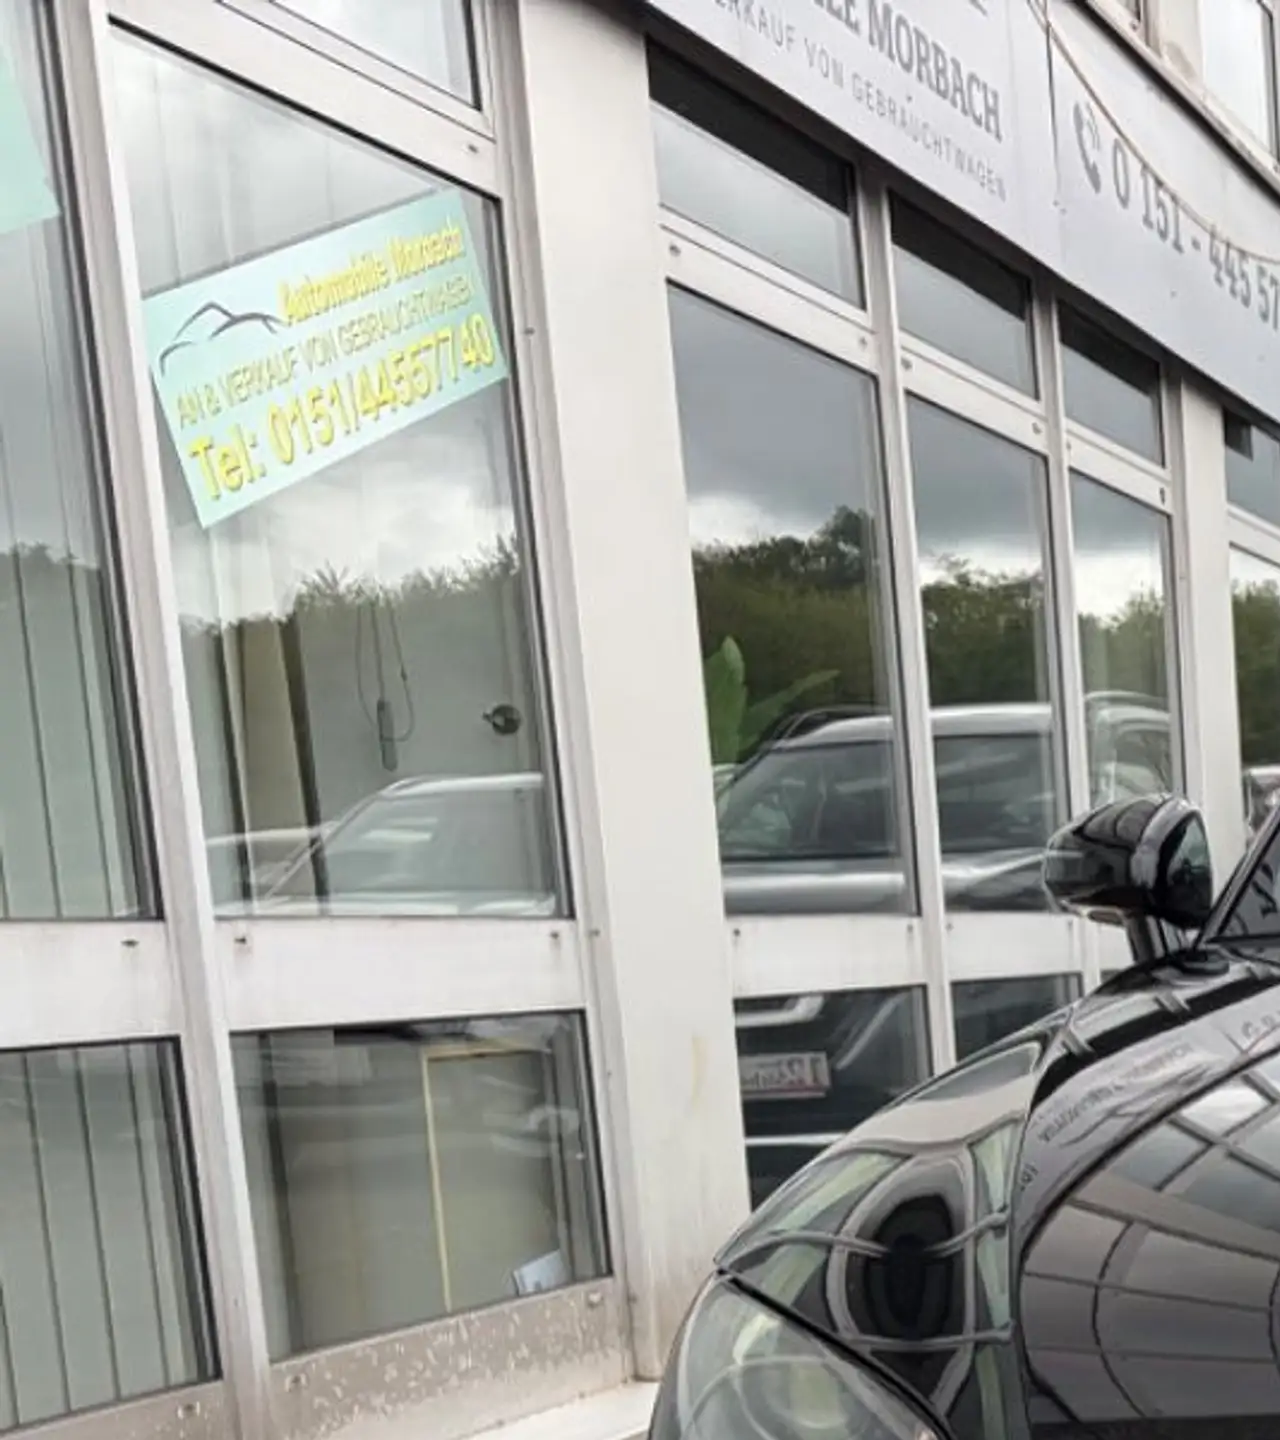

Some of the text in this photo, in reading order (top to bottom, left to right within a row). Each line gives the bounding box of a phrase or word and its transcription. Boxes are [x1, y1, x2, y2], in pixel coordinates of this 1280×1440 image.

[804, 37, 845, 88] VON
[851, 72, 1006, 202] GEBRAUCHTWAGEN
[867, 0, 1003, 143] MORBACH
[1112, 137, 1130, 210] 0
[1140, 163, 1185, 254] 151
[1209, 223, 1252, 309] 445
[189, 312, 496, 501] Tel: 0151/44557740
